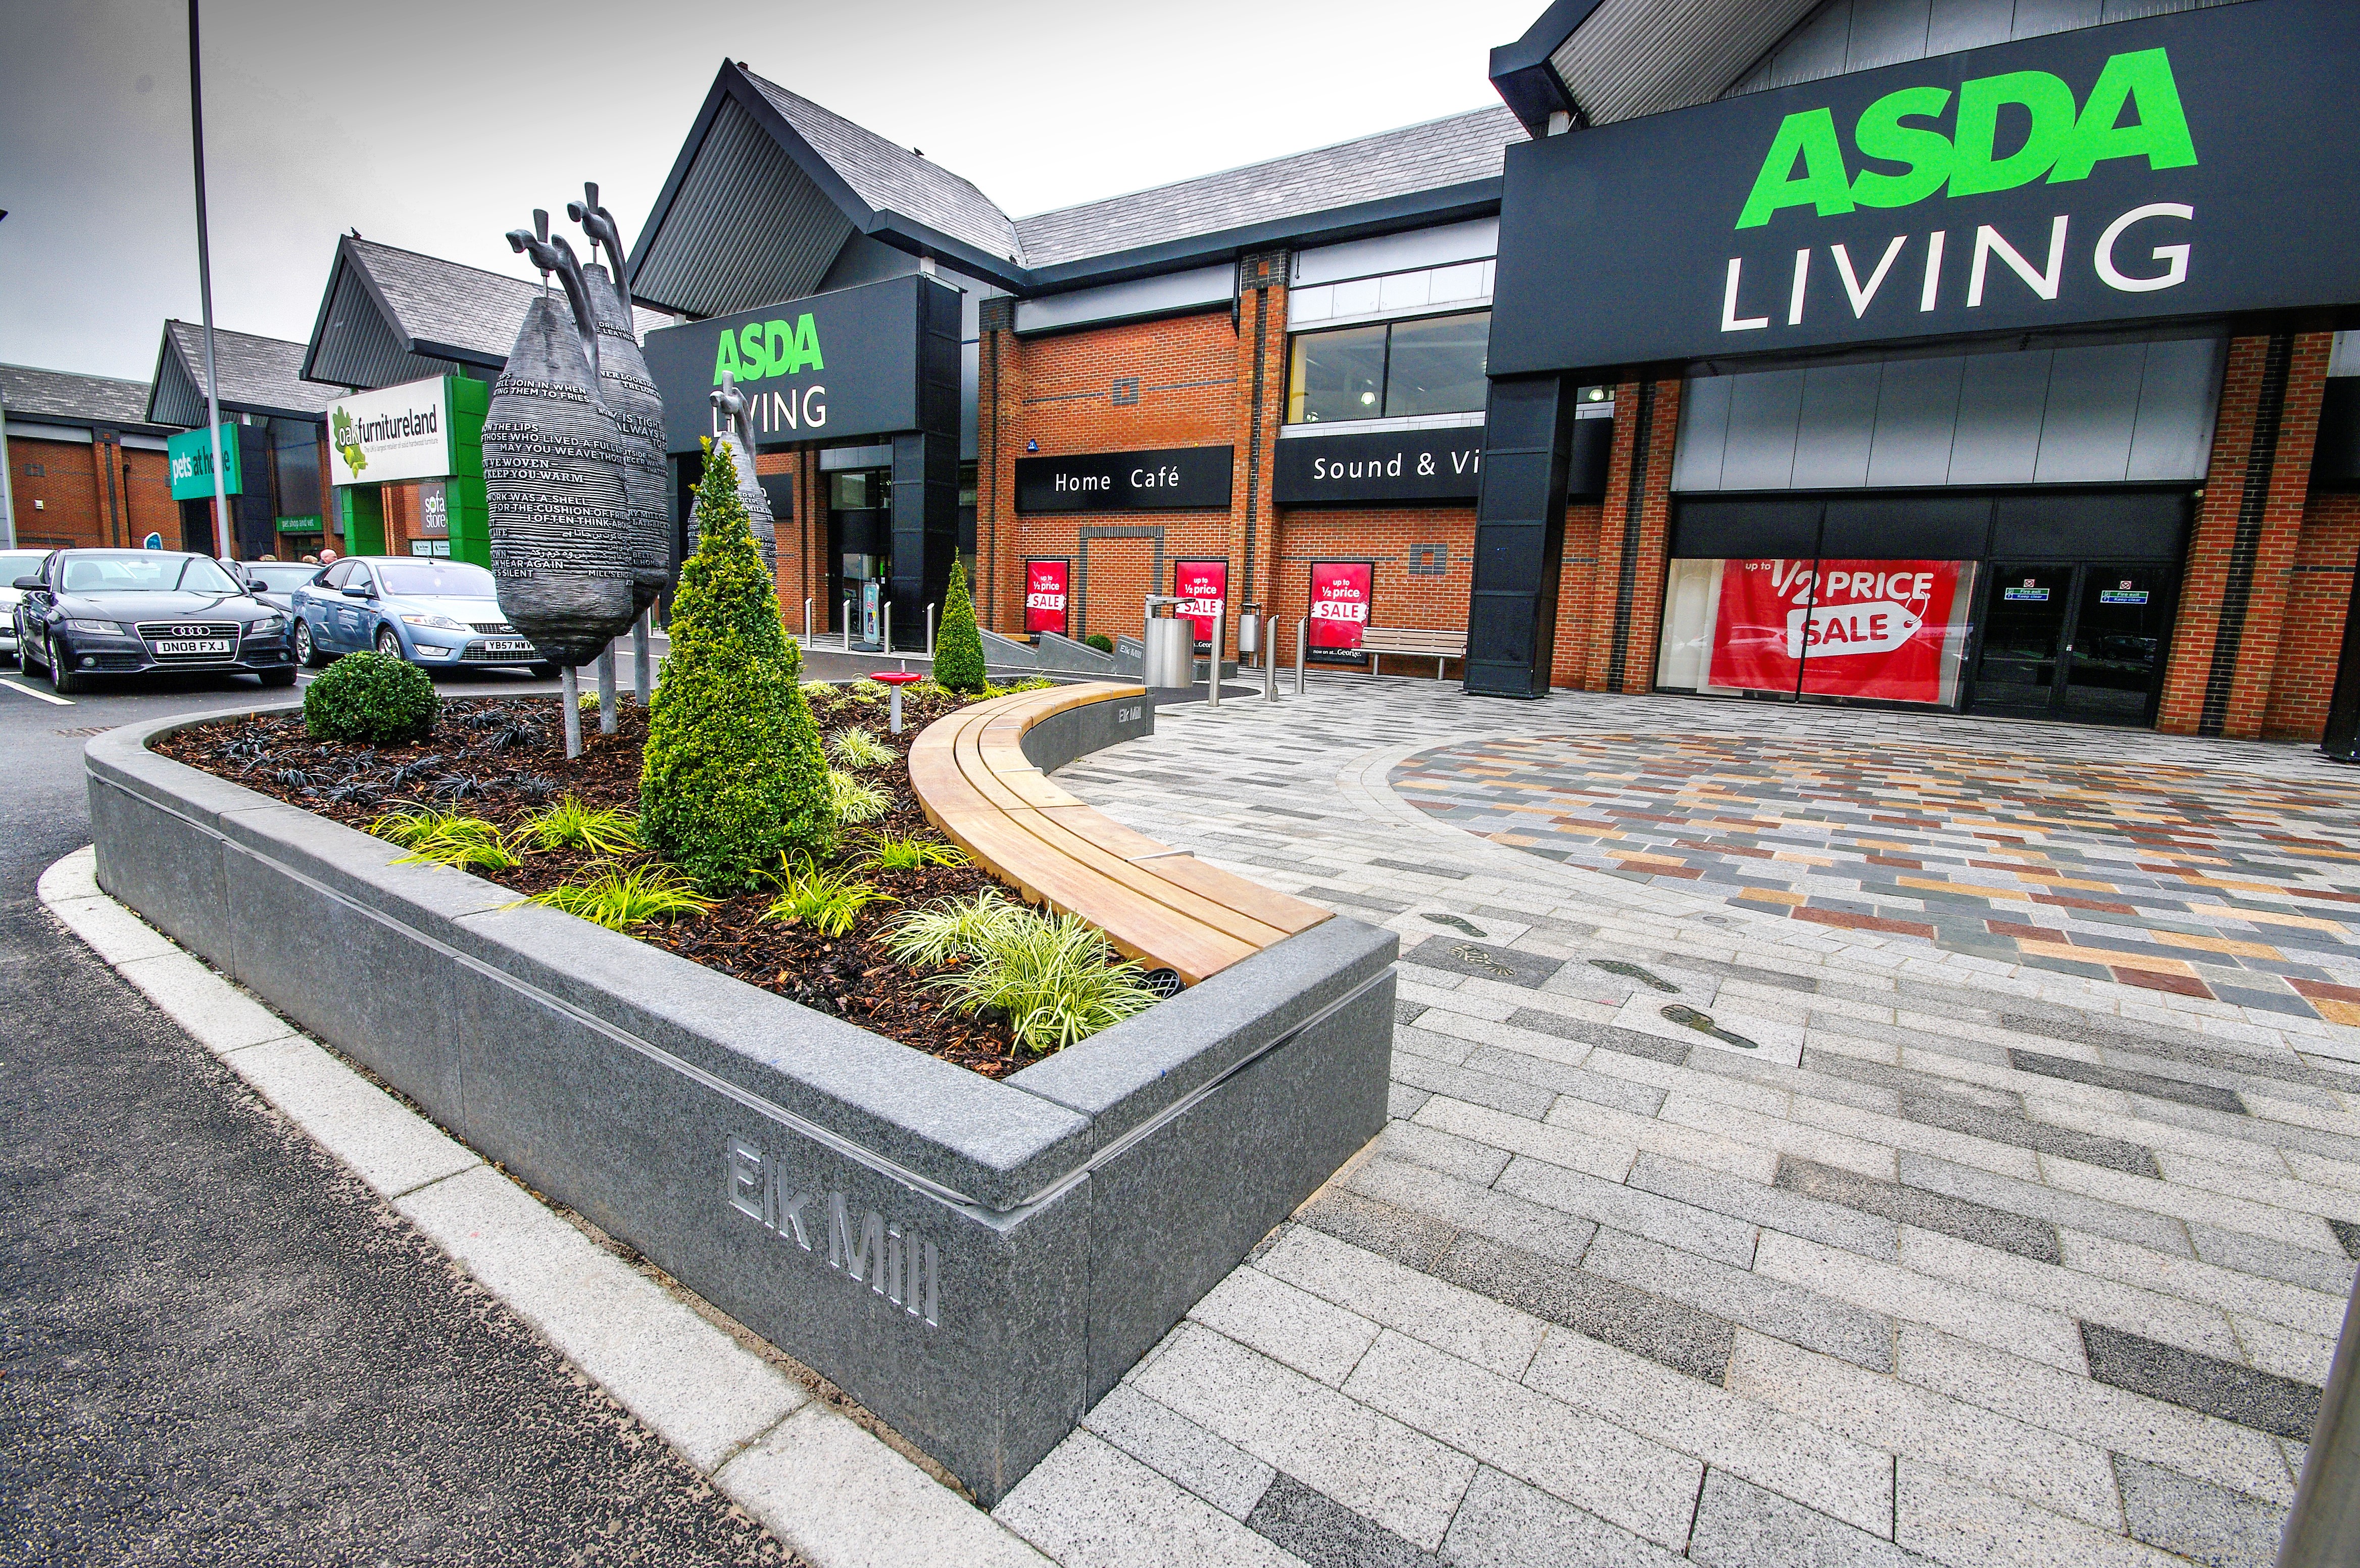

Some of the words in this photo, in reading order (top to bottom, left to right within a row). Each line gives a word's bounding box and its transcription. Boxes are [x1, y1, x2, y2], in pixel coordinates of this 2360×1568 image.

[1735, 46, 2198, 230] ASDA
[1720, 202, 2193, 332] LIVING
[713, 313, 824, 386] ASDA
[512, 380, 534, 388] JOIN
[553, 384, 586, 395] WHEN
[511, 387, 538, 396] THEM
[542, 389, 557, 398] TO
[561, 393, 590, 403] FRIES
[493, 423, 511, 431] THE
[514, 423, 538, 432] LIPS
[510, 433, 539, 442] WHO
[544, 435, 579, 446] LIVED
[526, 445, 551, 453] YOU
[555, 447, 597, 458] WEAVE
[172, 452, 192, 485] pets
[193, 449, 203, 476] at
[203, 446, 230, 474] hoe
[503, 459, 549, 468] WOVEN
[1314, 453, 1402, 479] Sound
[1417, 453, 1435, 475] &
[487, 470, 509, 479] KEEP
[510, 470, 536, 479] YOU
[538, 471, 583, 483] WARM
[1056, 473, 1110, 492] Home
[1131, 466, 1178, 488] Café
[425, 489, 446, 513] sofa
[511, 494, 535, 502] WAS
[552, 495, 588, 506] SHELL
[512, 504, 533, 512] THE
[536, 505, 591, 516] CUSHION
[426, 513, 446, 528] store
[534, 515, 574, 524] OFTEN
[575, 516, 609, 526] THINK
[527, 559, 563, 569] AGAIN
[1745, 563, 1758, 571] up
[1761, 562, 1771, 570] to
[503, 569, 533, 577] SILENT
[588, 570, 615, 578] MILL'S
[1041, 581, 1060, 592] price
[1194, 584, 1217, 596] price
[1827, 571, 1934, 600] PRICE
[1333, 586, 1360, 599] price
[1033, 596, 1059, 607] SALE
[1185, 600, 1216, 613] SALE
[1321, 604, 1358, 618] SALE
[1801, 614, 1888, 646] SALE
[163, 642, 196, 652] DN08
[200, 642, 224, 651] FXJ
[1119, 645, 1130, 655] Elk
[1130, 648, 1142, 659] Mill
[1119, 708, 1129, 723] Elk
[1129, 706, 1141, 721] Mill
[728, 1134, 811, 1251] Elk
[828, 1190, 939, 1327] Mill
